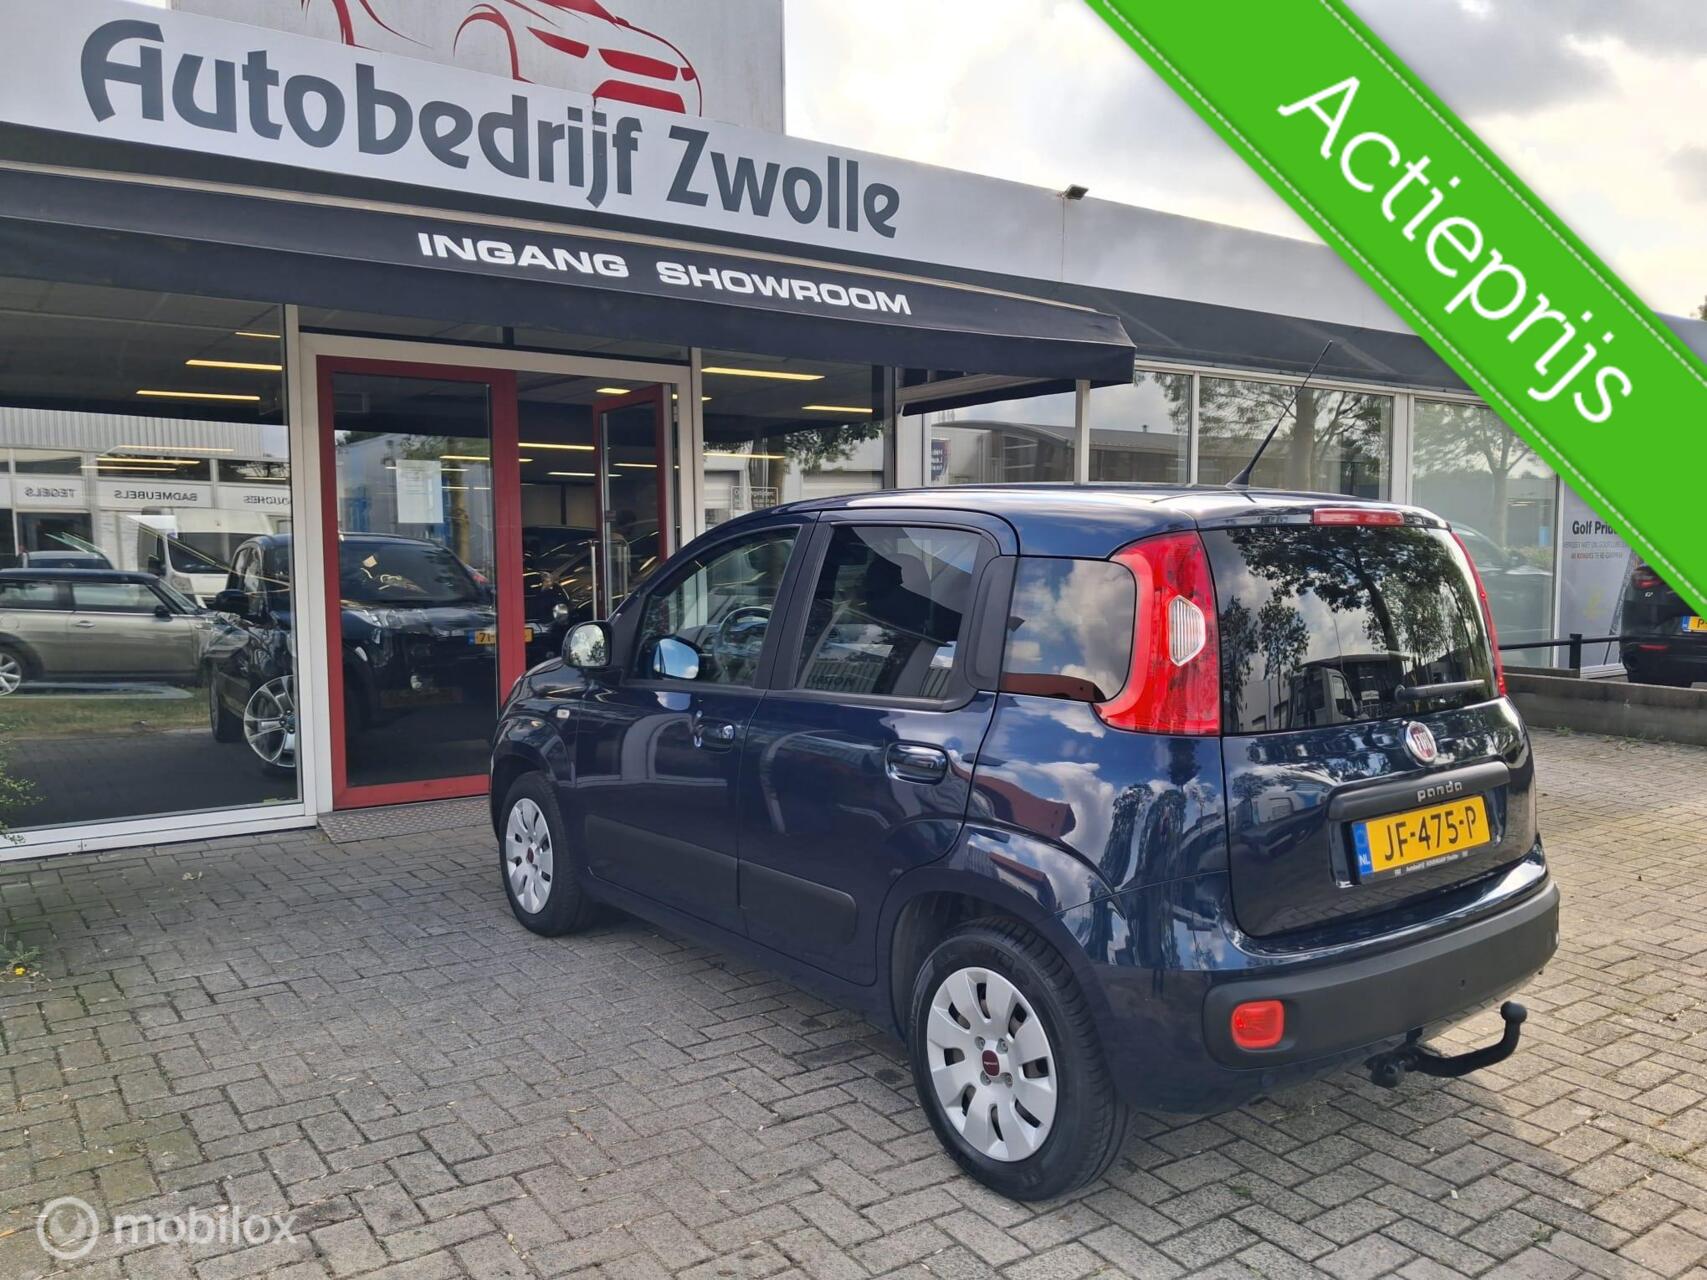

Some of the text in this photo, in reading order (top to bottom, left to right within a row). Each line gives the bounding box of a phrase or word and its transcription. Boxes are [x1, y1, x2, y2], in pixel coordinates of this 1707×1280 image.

[81, 19, 900, 238] Autobedrijf Zwolle
[418, 232, 912, 315] INGANG SHOWROOM
[1572, 520, 1593, 535] Golf
[1417, 781, 1462, 802] panda
[1385, 805, 1476, 861] JF-475-P
